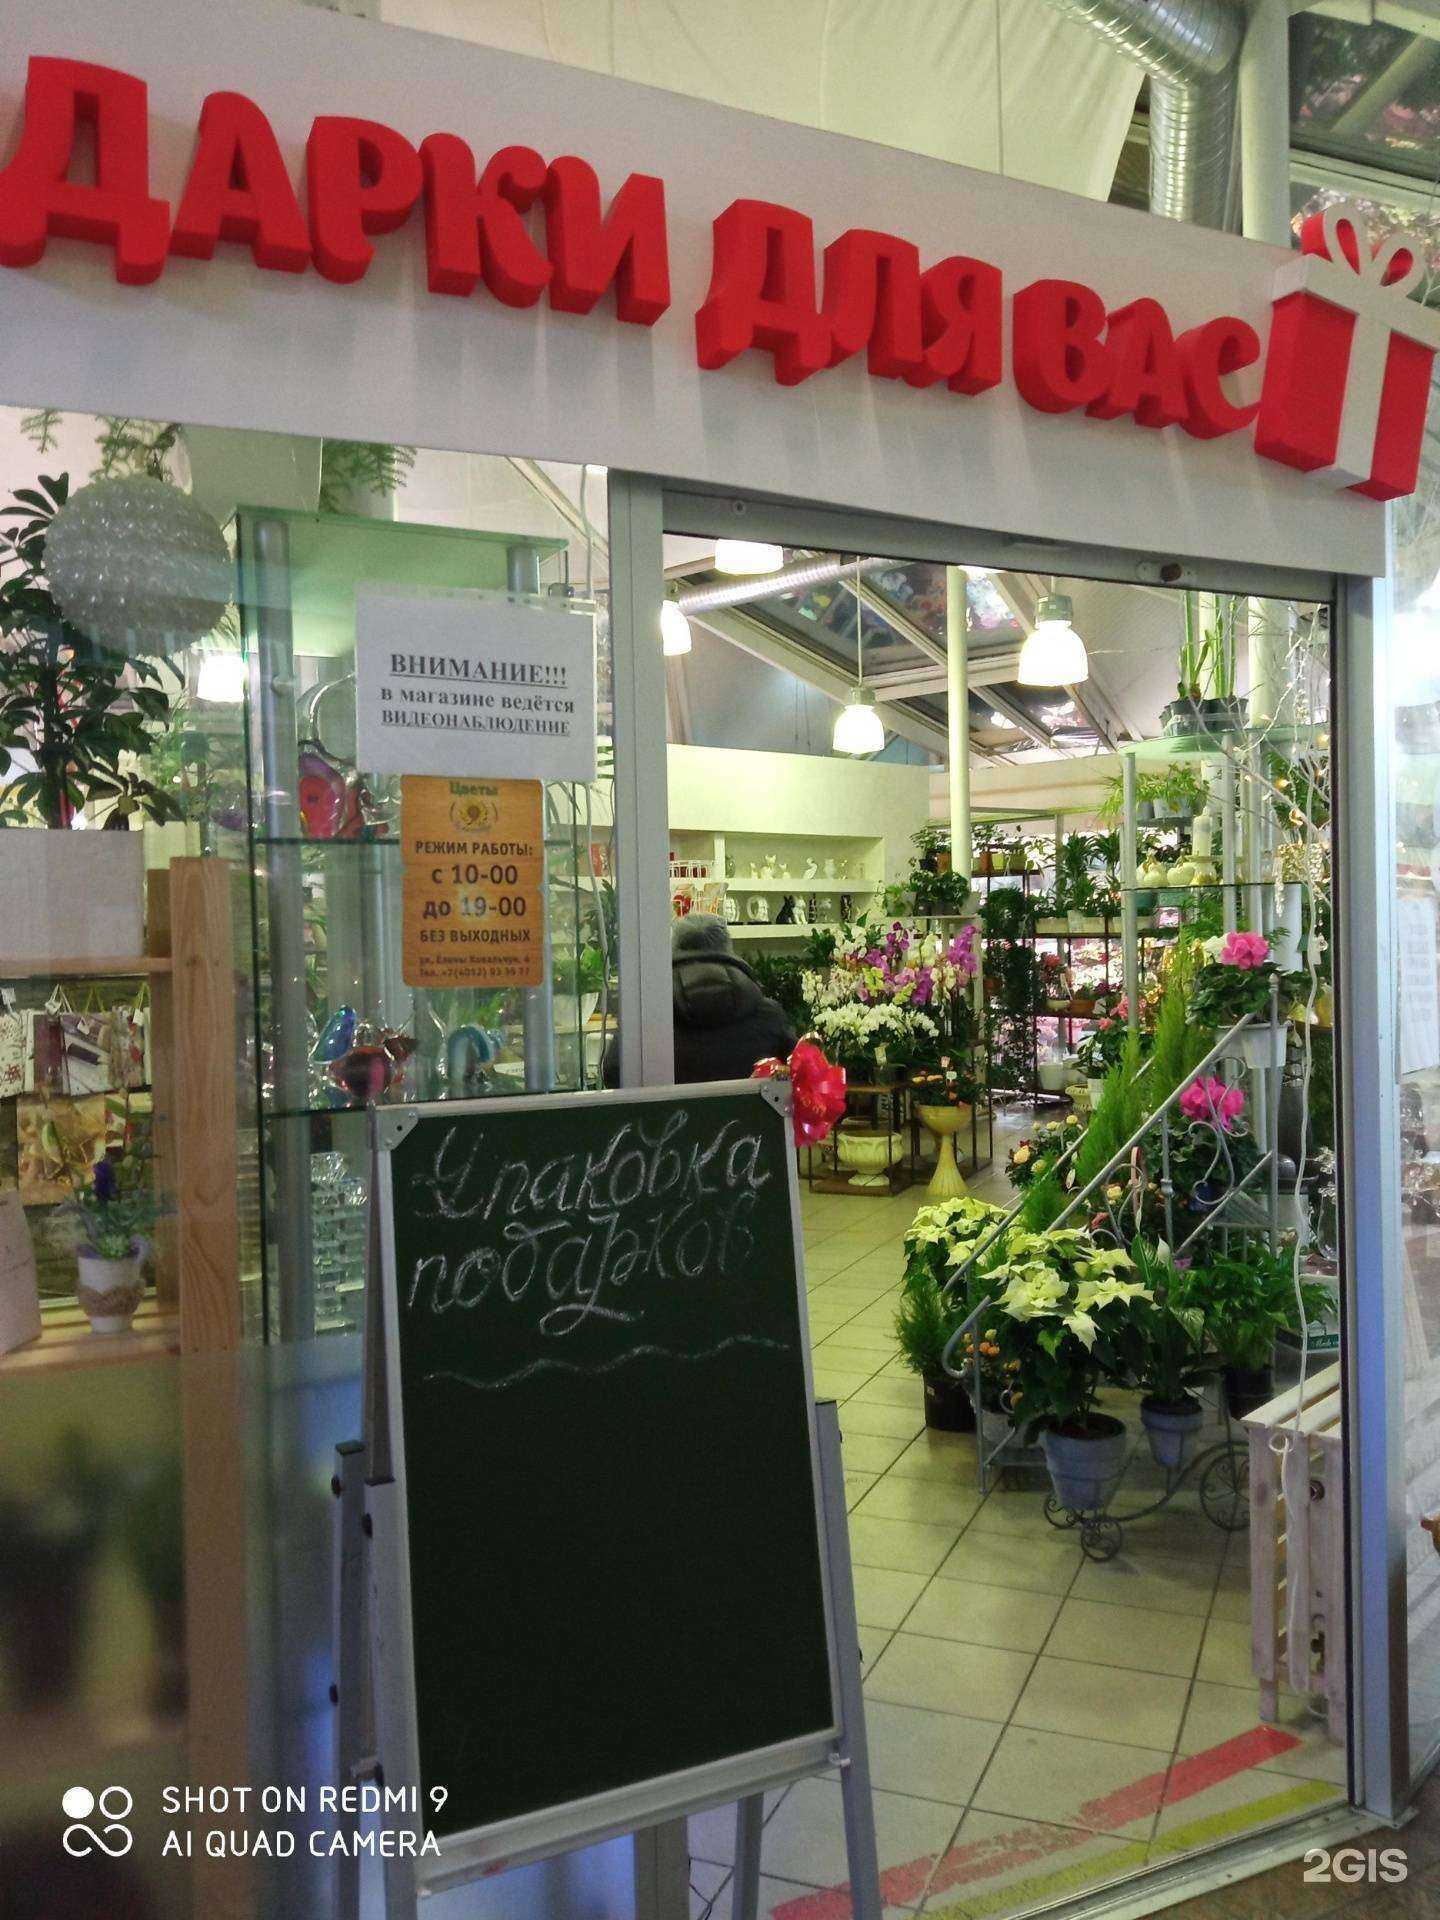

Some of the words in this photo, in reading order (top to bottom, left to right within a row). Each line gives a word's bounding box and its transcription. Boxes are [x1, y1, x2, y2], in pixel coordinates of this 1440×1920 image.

[694, 198, 1003, 387] ДЛЯ
[1012, 279, 1263, 440] ВАС
[390, 653, 567, 689] ВНИМАНИЕ!!!
[400, 689, 495, 708] магазине
[501, 694, 576, 714] ведётся
[381, 708, 571, 737] ВИДЕОНАБЛЮДЕНИЕ
[415, 840, 468, 855] РЕЖИМ
[471, 842, 533, 856] РАБОТЫ:
[452, 863, 519, 885] 10-00
[461, 896, 527, 917] 19-00
[419, 929, 446, 943] БЕЗ
[450, 929, 531, 944] ВЫХОДНЫХ
[411, 1109, 772, 1221] Упаковка
[407, 1190, 759, 1337] подарков
